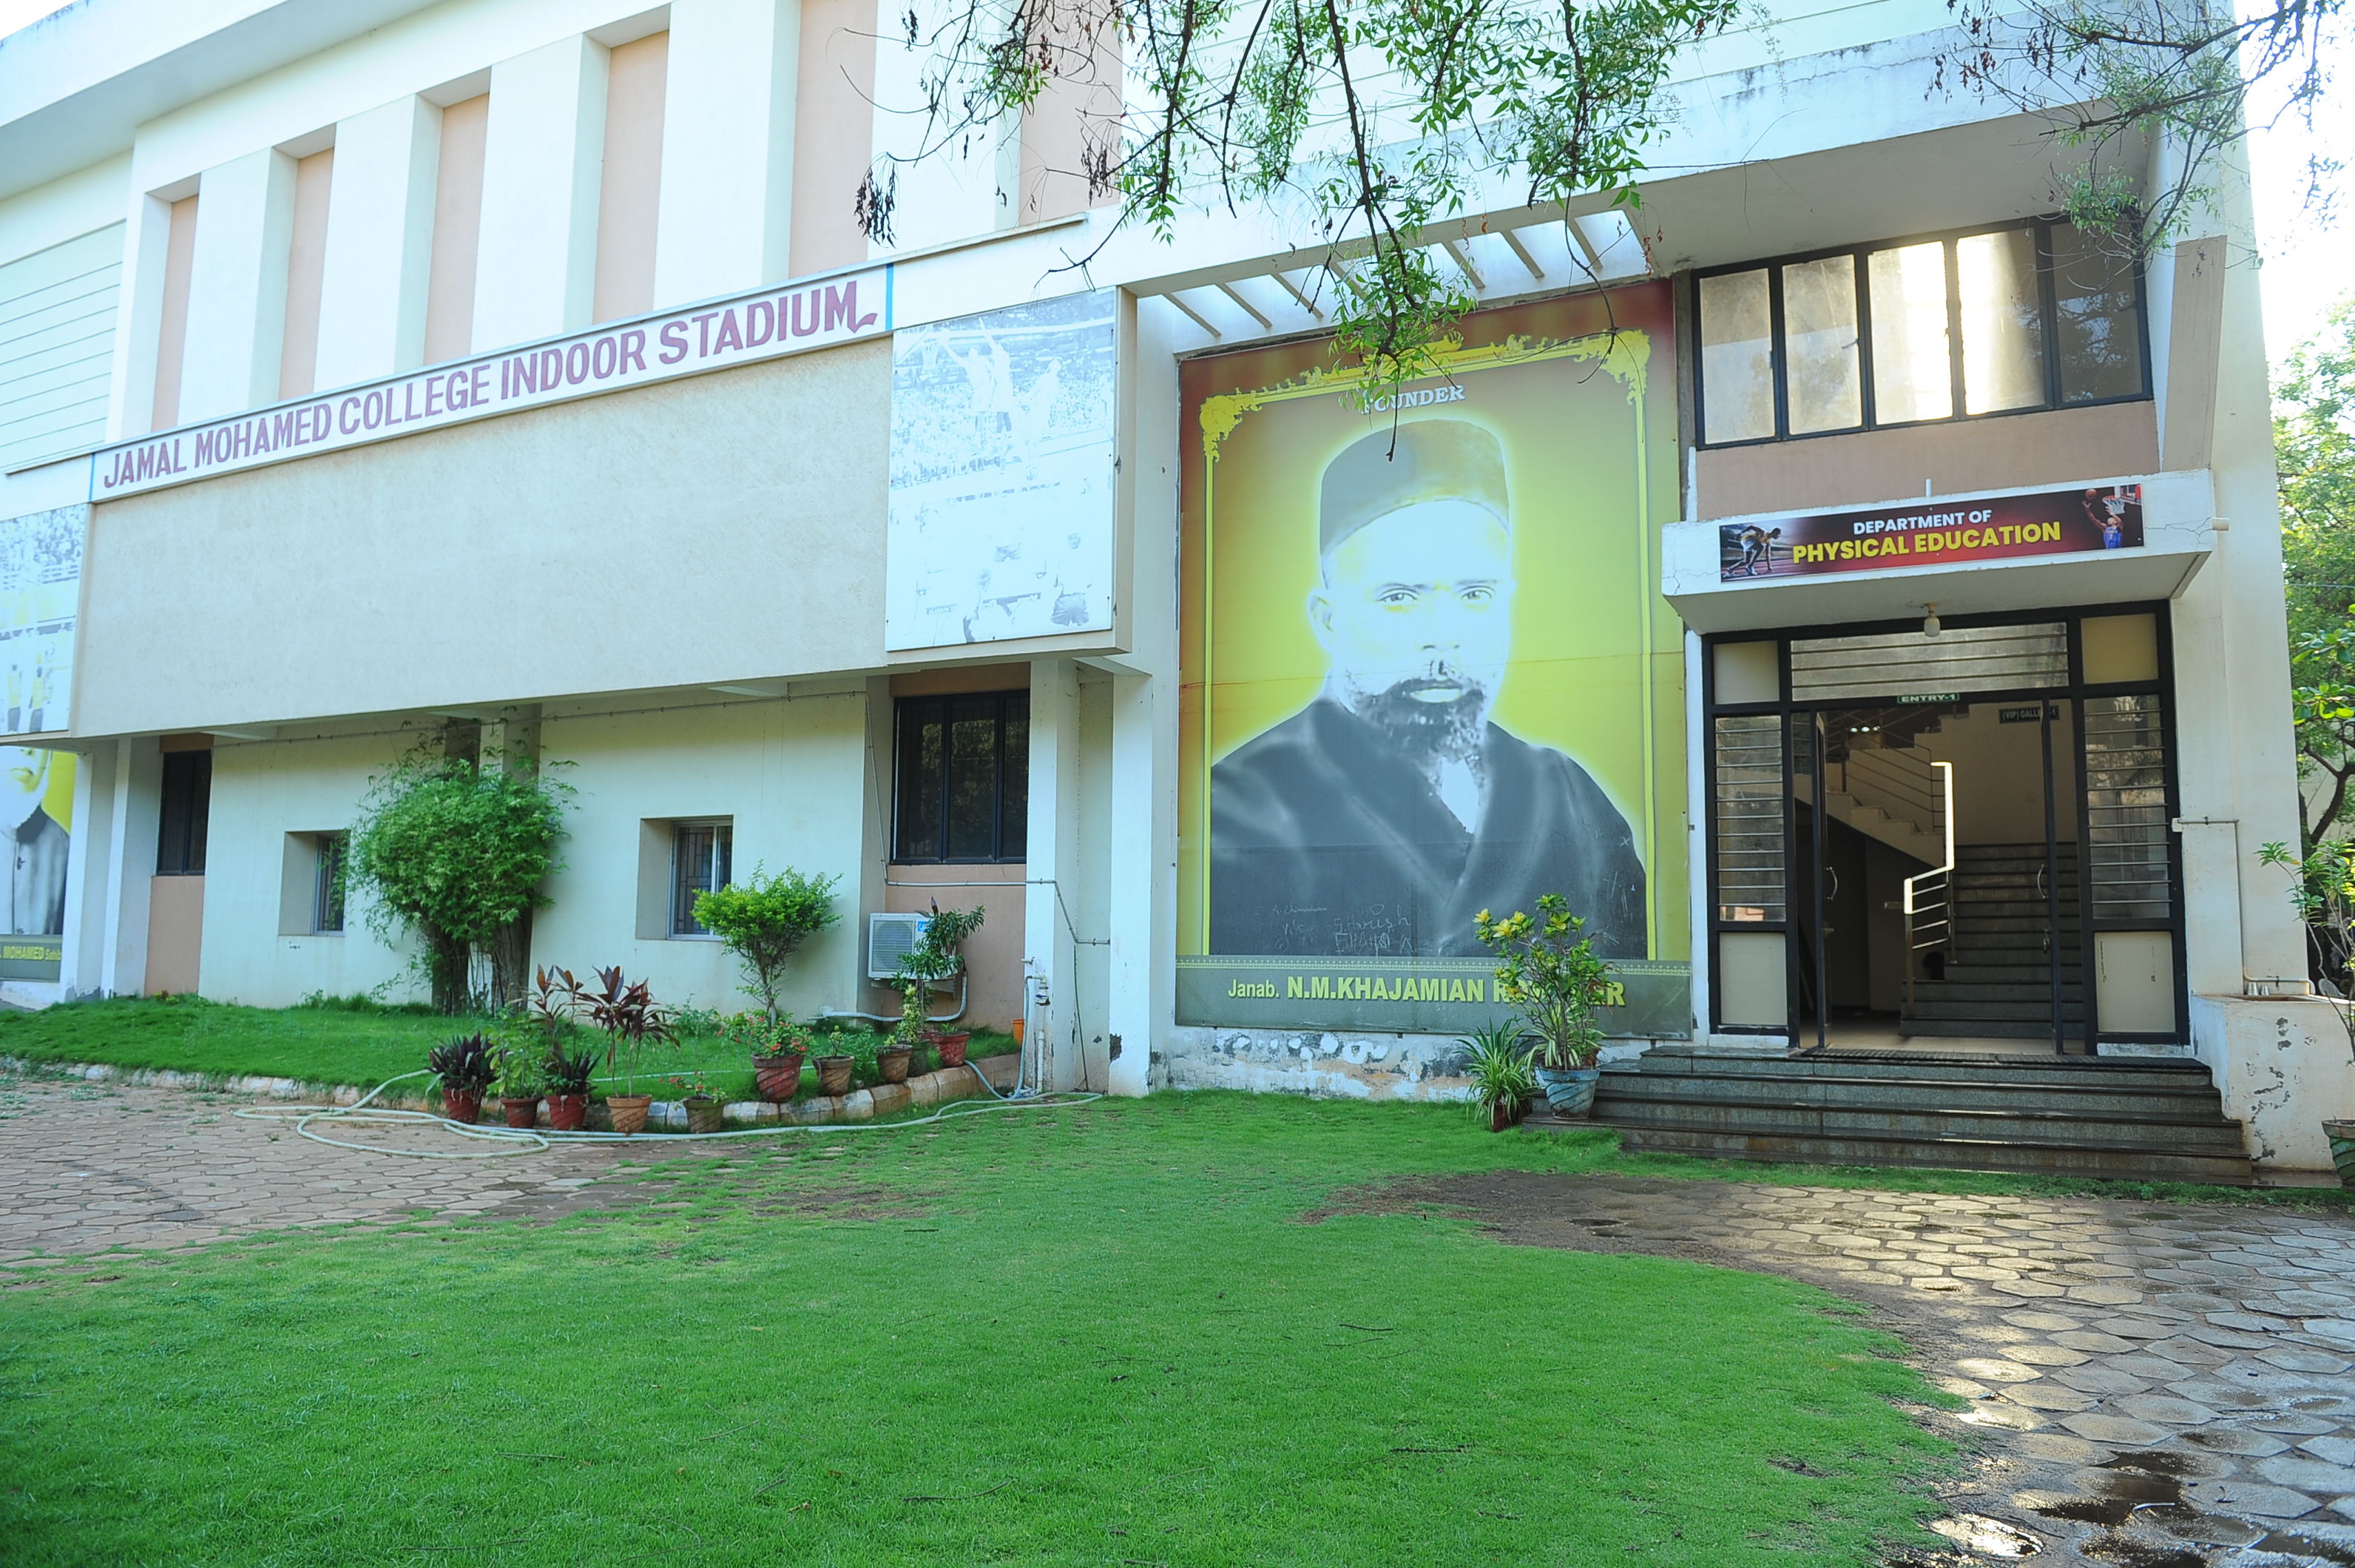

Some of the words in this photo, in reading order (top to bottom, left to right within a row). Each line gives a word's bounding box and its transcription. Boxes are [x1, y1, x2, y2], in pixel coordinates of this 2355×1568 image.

[104, 438, 187, 489] JAMAL
[194, 403, 332, 468] MOHAMED
[338, 363, 490, 435] COLLEGE
[500, 329, 646, 400] INDOOR
[658, 280, 878, 365] STADIUM
[1853, 512, 1965, 535] DEPARTMENT
[1968, 509, 1993, 524] OF
[1792, 535, 1910, 564] PHYSICAL
[1914, 521, 2061, 553] EDUCATION
[1901, 694, 1956, 703] ENTRY-1
[3, 945, 44, 960] MOHAMED
[1228, 979, 1280, 998] Janab.
[1287, 976, 1484, 1003] N.M.KHAJAMIAN
